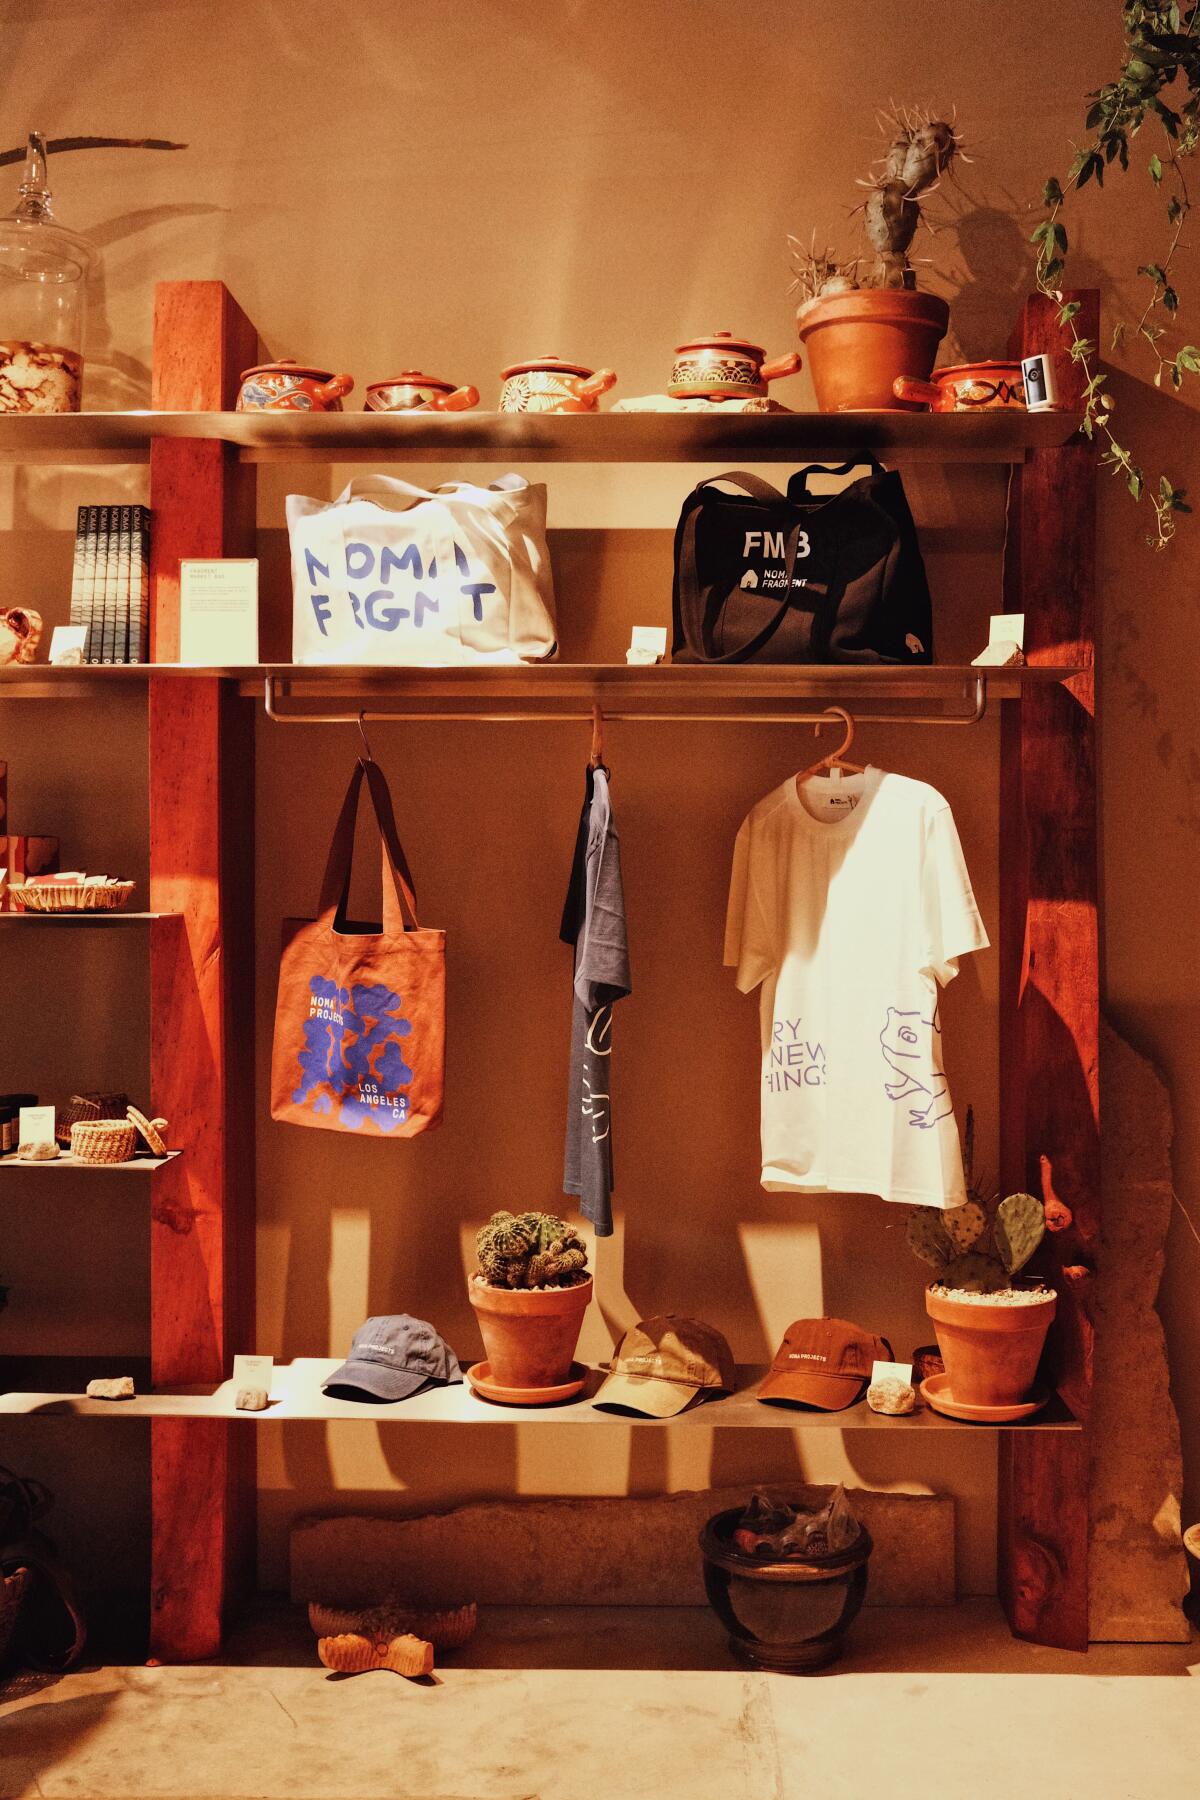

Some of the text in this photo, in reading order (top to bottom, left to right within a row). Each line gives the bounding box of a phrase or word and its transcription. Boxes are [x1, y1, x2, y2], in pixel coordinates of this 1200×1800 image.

[742, 530, 811, 559] FMB
[763, 569, 788, 579] NOM
[310, 995, 335, 1009] NOMA
[773, 1017, 802, 1043] RY
[771, 1041, 826, 1069] NEW
[765, 1064, 827, 1093] HING
[358, 1083, 378, 1094] LOS
[359, 1093, 406, 1108] ANGELES
[392, 1108, 406, 1119] CA
